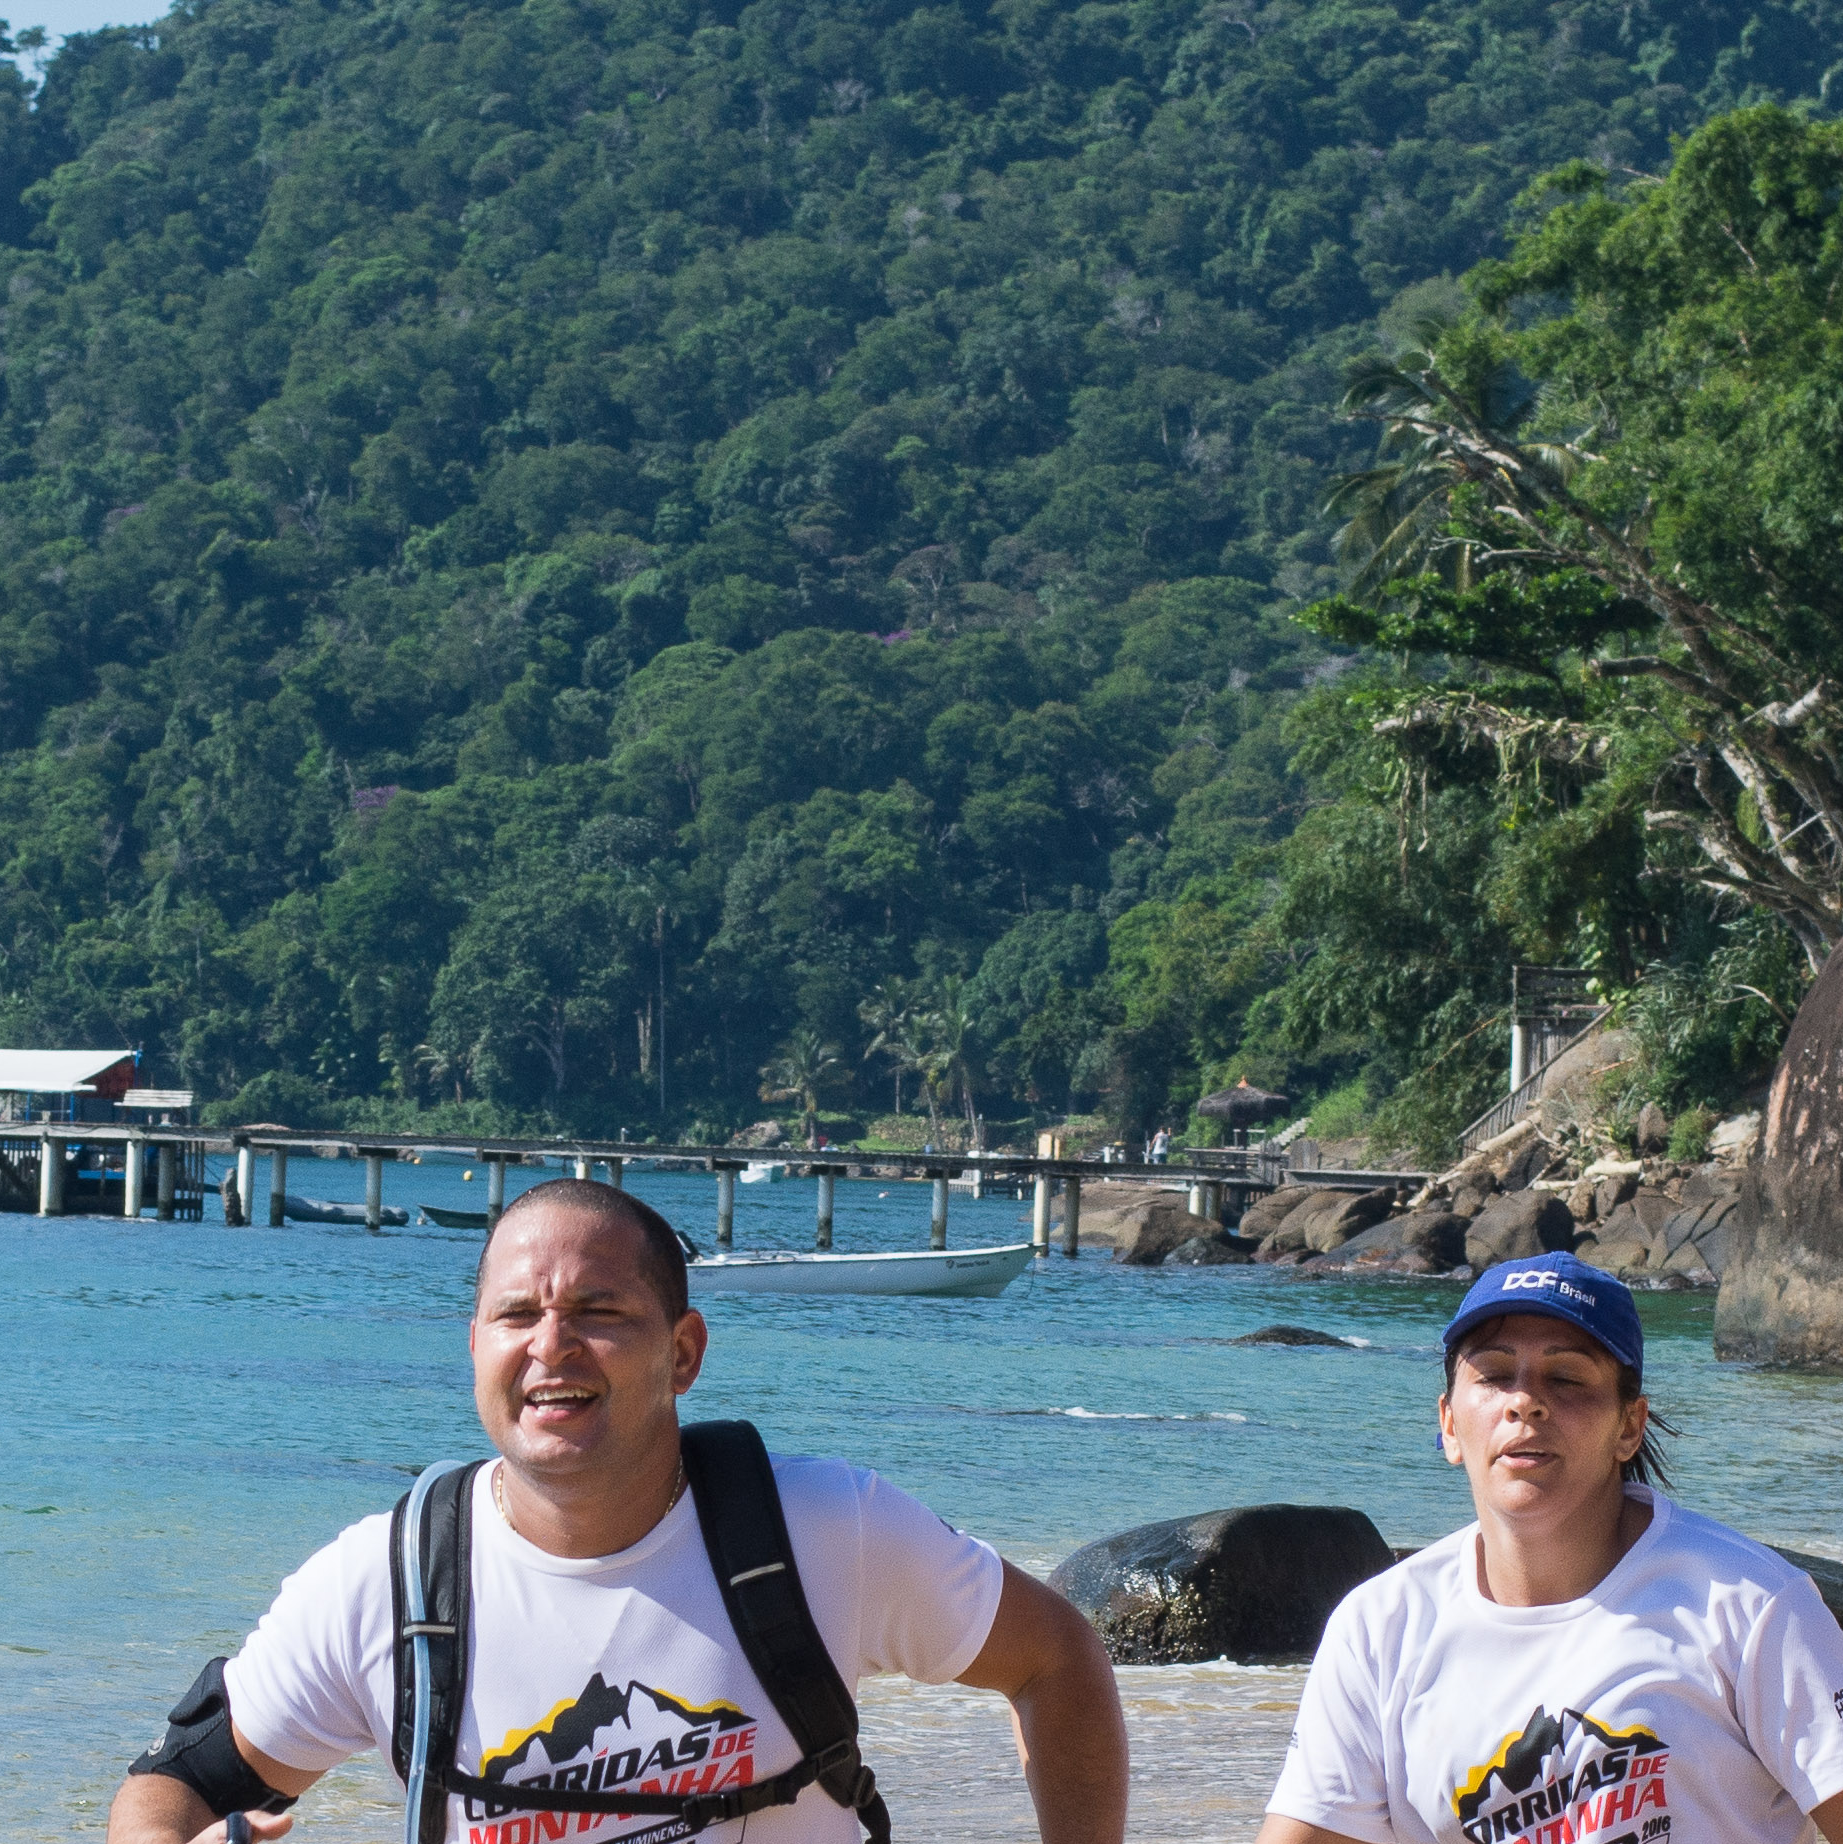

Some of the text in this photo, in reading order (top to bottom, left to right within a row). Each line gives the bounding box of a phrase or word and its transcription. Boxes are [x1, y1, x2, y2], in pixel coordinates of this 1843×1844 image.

[1502, 1270, 1596, 1307] DCF Brasil
[711, 1726, 758, 1760] DE
[1628, 1753, 1670, 1780] DE
[1642, 1815, 1671, 1842] 2016
